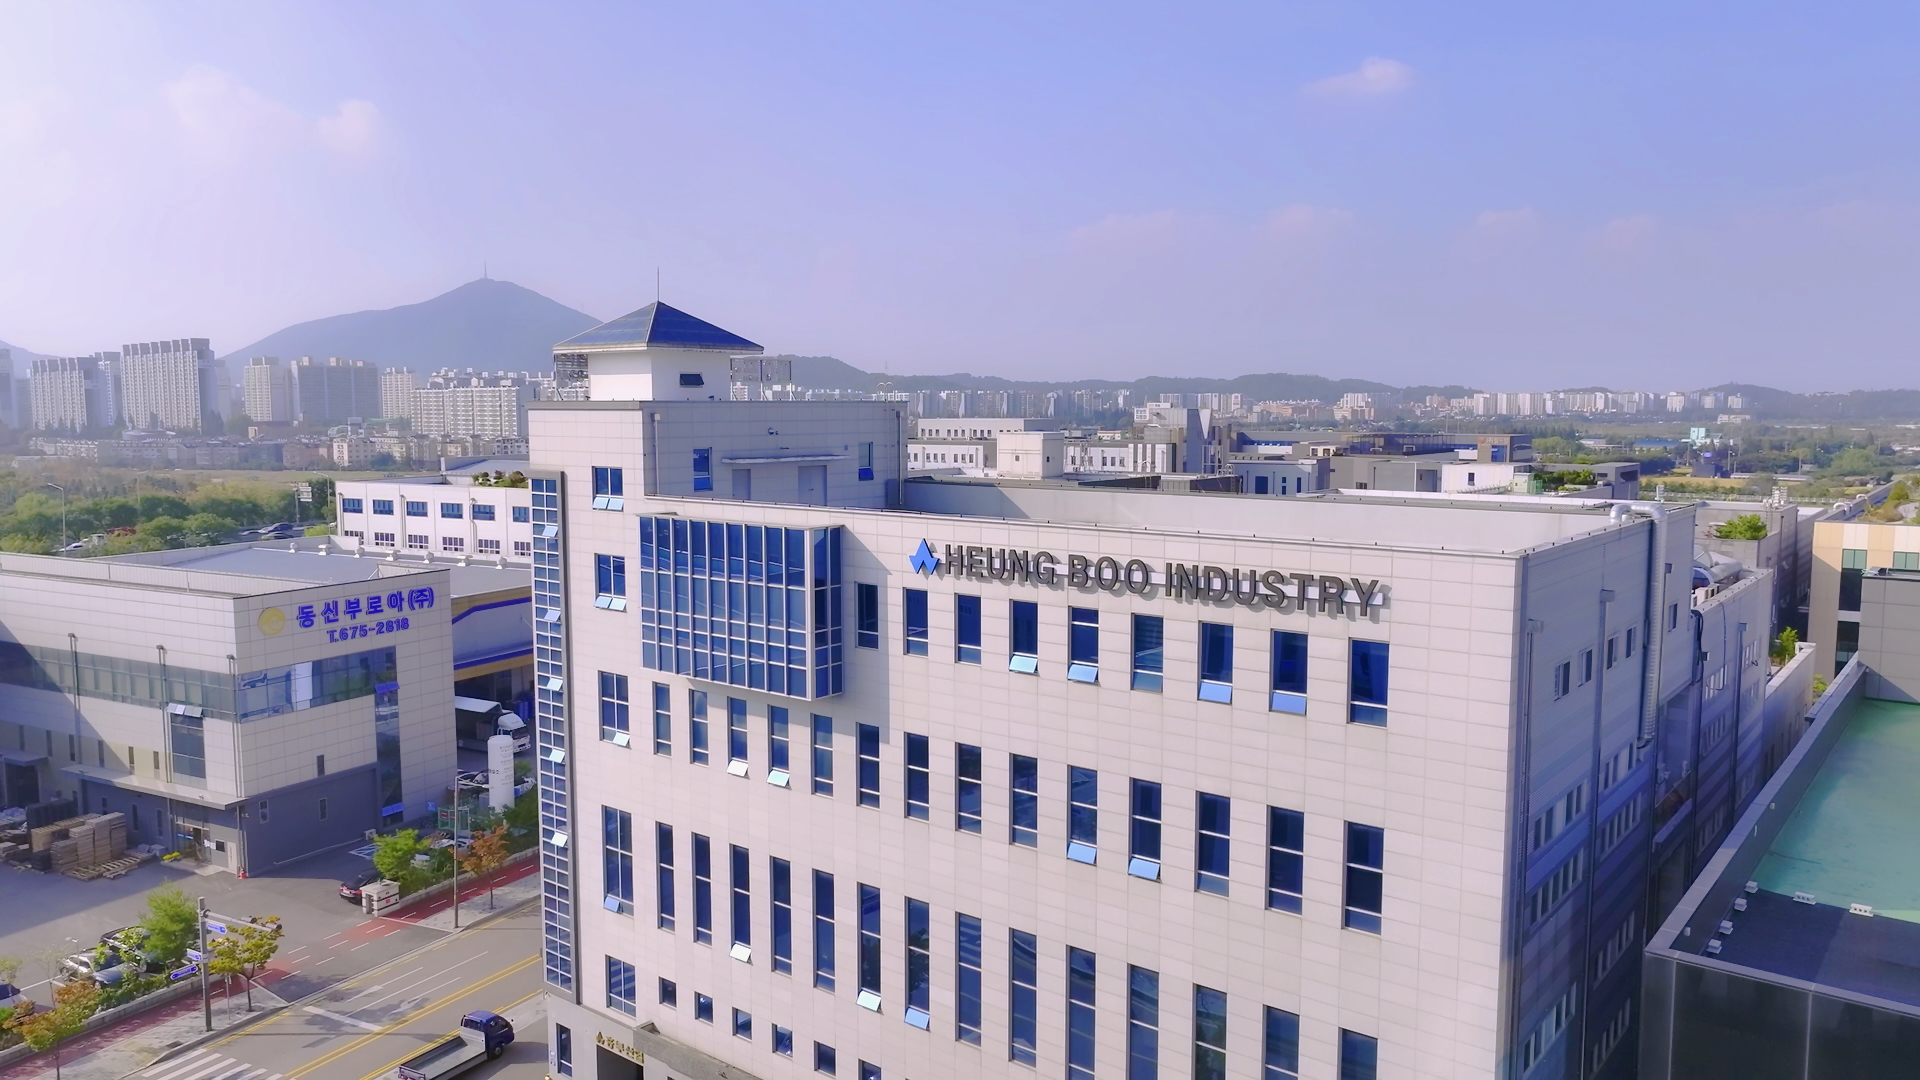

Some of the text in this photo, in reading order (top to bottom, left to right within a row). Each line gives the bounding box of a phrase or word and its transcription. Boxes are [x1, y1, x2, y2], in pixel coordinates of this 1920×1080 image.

[944, 544, 1379, 616] HEUNG BOO INDUSTRY
[327, 617, 410, 643] T.675-2818
